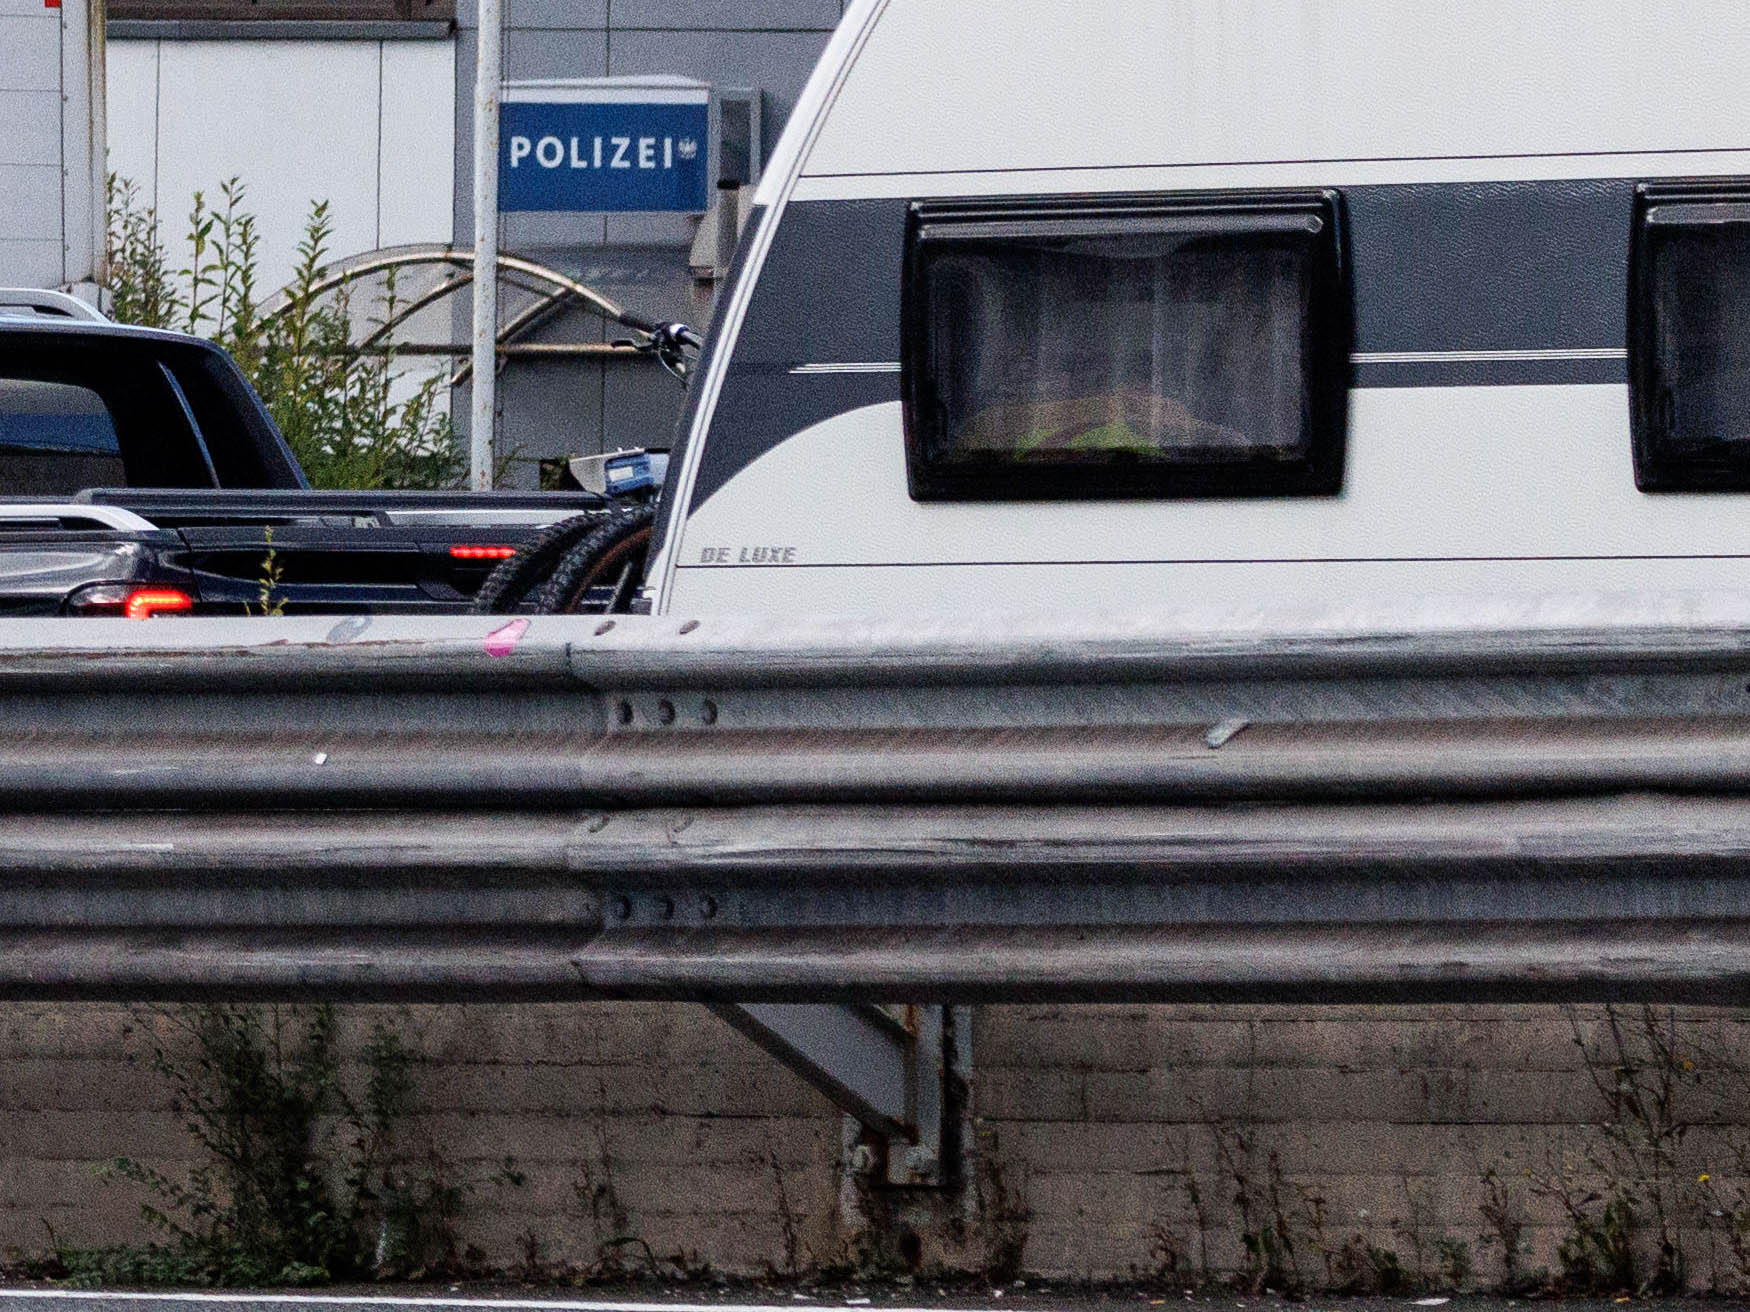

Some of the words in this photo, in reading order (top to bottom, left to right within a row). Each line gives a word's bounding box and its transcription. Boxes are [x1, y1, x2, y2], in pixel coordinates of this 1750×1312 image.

[508, 134, 674, 170] POLIZEI
[699, 546, 732, 564] DE
[738, 545, 798, 564] LUXE
